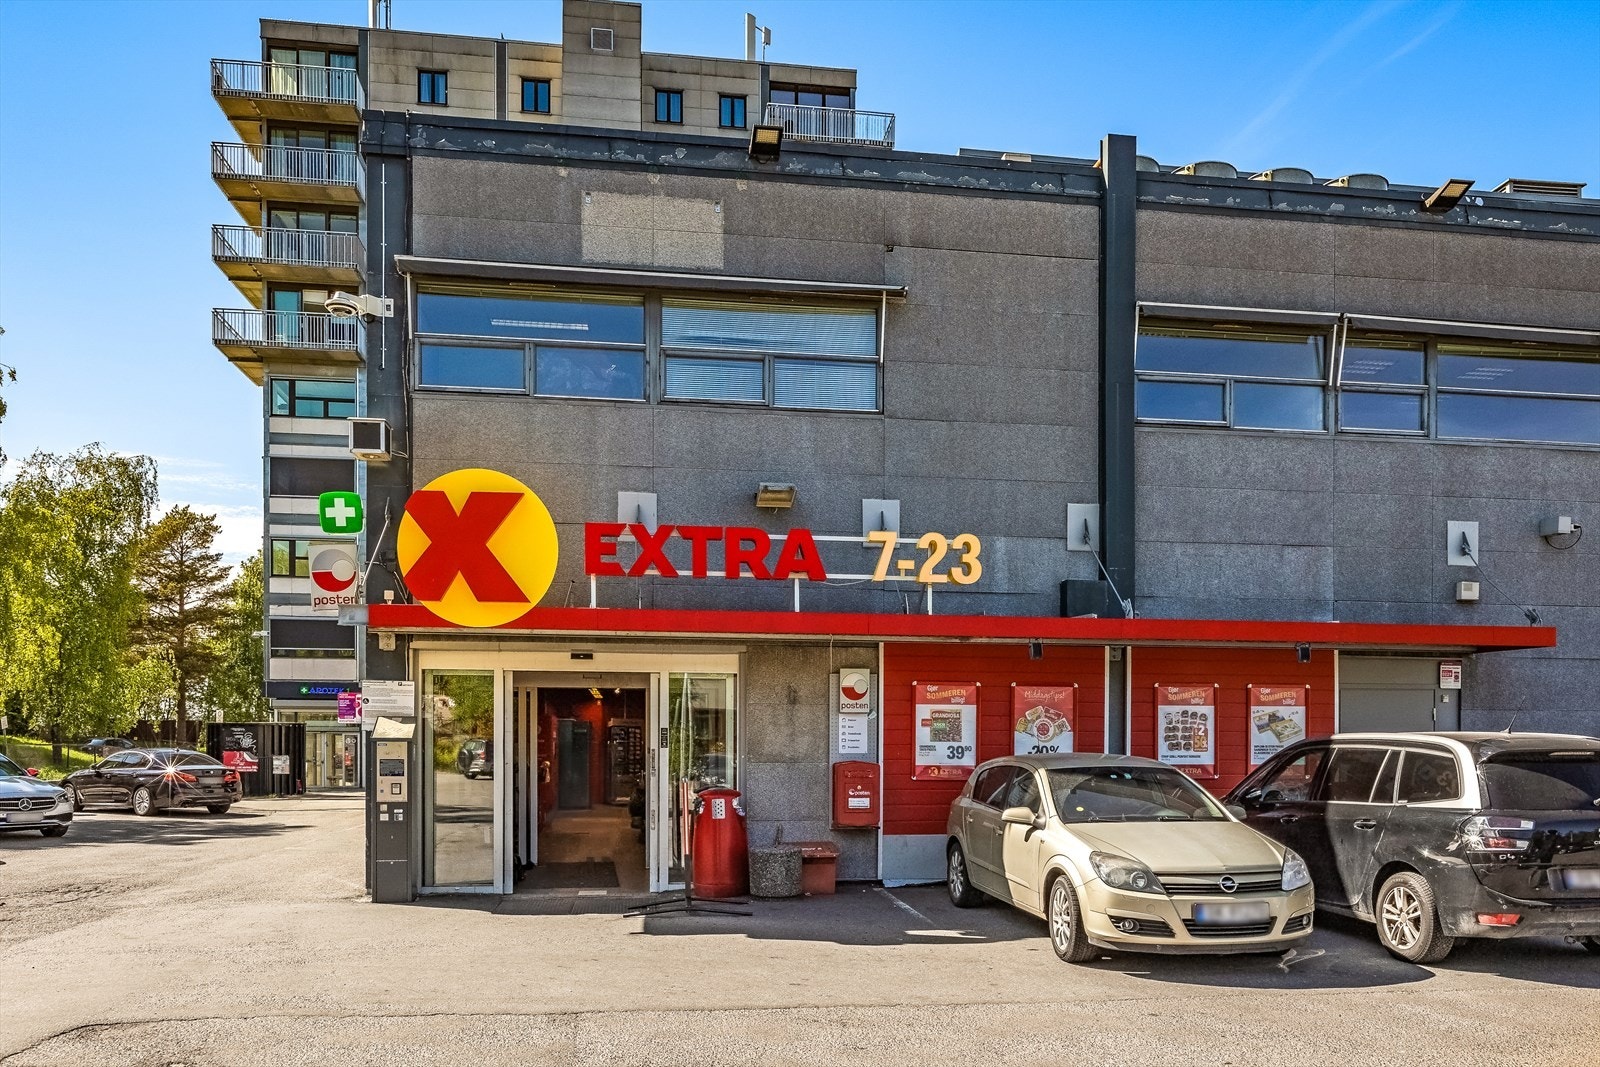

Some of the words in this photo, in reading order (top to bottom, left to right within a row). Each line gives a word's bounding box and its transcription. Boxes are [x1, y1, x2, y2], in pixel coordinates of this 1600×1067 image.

[585, 522, 827, 582] EXTRA
[866, 530, 982, 585] 7-23
[926, 689, 967, 700] SOMMEREN
[1167, 690, 1205, 701] SOMMEREN
[1260, 691, 1297, 702] SOMMEREN
[841, 702, 869, 710] posten
[946, 745, 965, 760] 39
